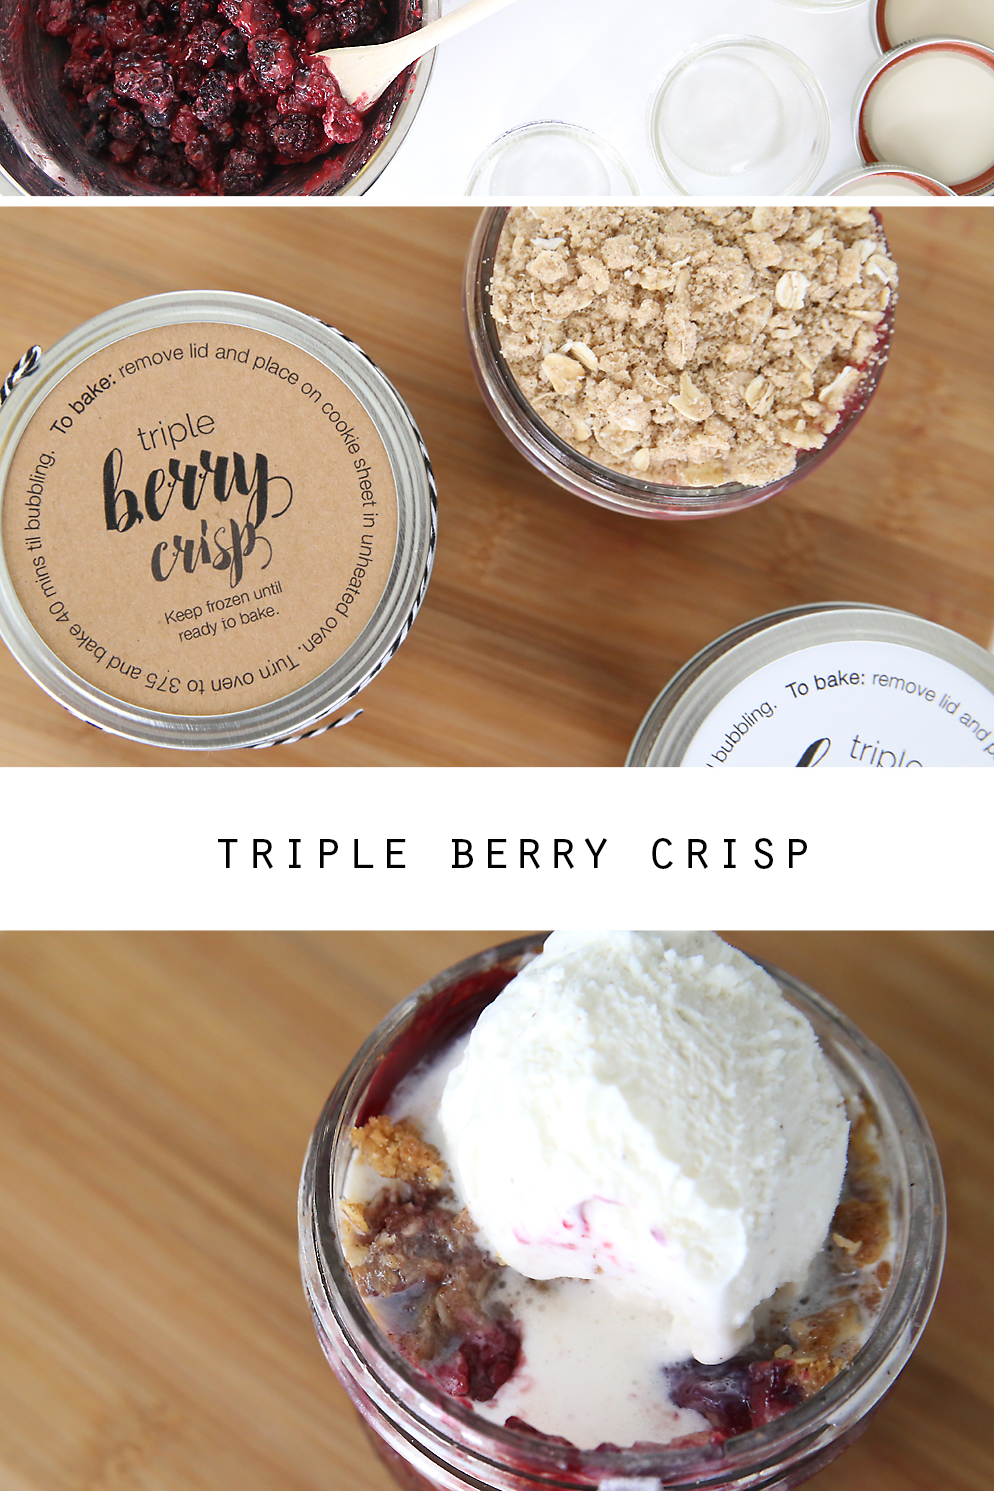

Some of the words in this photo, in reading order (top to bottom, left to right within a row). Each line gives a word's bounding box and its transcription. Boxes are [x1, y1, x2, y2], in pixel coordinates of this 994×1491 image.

[119, 347, 184, 378] remove
[189, 343, 208, 358] lid
[215, 347, 250, 363] and
[252, 355, 299, 385] place
[68, 373, 117, 414] bake:
[300, 382, 322, 403] on
[50, 415, 73, 434] To
[137, 412, 215, 451] triple
[321, 402, 361, 454] cookie
[24, 450, 56, 531] bubbling.
[103, 447, 293, 533] berry
[353, 458, 377, 508] sheet
[362, 513, 379, 528] in
[25, 536, 42, 552] til
[151, 518, 273, 589] crisp
[32, 555, 57, 598] mins
[335, 533, 374, 618] unheated
[49, 600, 70, 624] 40
[164, 605, 203, 624] Keep
[206, 591, 250, 613] frozen
[253, 580, 283, 600] until
[178, 621, 218, 642] ready
[221, 616, 237, 631] to
[240, 606, 279, 625] bake.
[298, 616, 338, 652] oven.
[69, 623, 107, 664] bake
[106, 655, 142, 680] and
[144, 672, 181, 694] 375
[211, 672, 254, 691] oven
[259, 654, 300, 679] Turn
[187, 679, 204, 695] to
[711, 701, 777, 764] bubbling.
[785, 681, 809, 699] To
[814, 670, 866, 691] bake:
[872, 672, 936, 702] remove
[938, 694, 961, 715] lid
[959, 712, 993, 742] and
